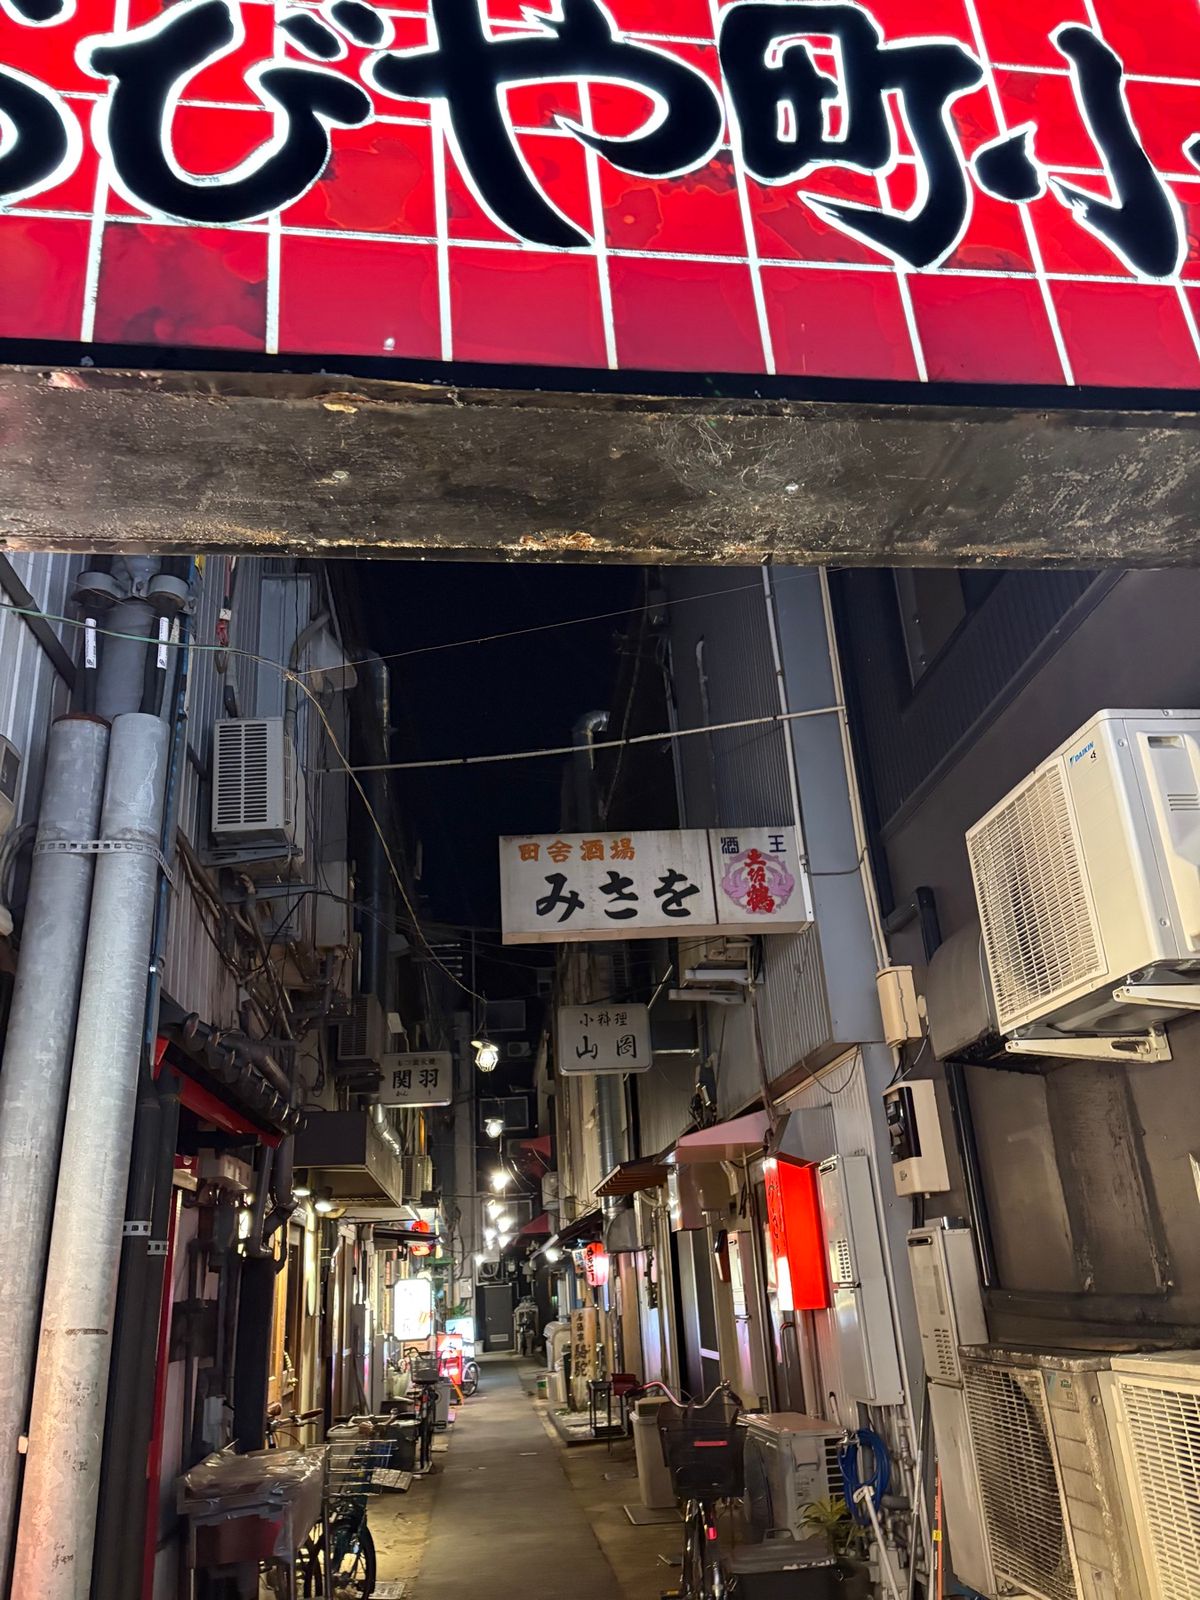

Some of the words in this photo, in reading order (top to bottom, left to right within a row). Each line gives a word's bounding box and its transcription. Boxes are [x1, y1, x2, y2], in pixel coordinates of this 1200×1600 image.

[1075, 741, 1094, 761] DAIKIN
[518, 837, 636, 864] 田舎酒場
[744, 848, 775, 913] 土佐鶴
[536, 868, 700, 922] みさを
[579, 1011, 629, 1027] 小料理
[392, 1068, 439, 1089] 関羽
